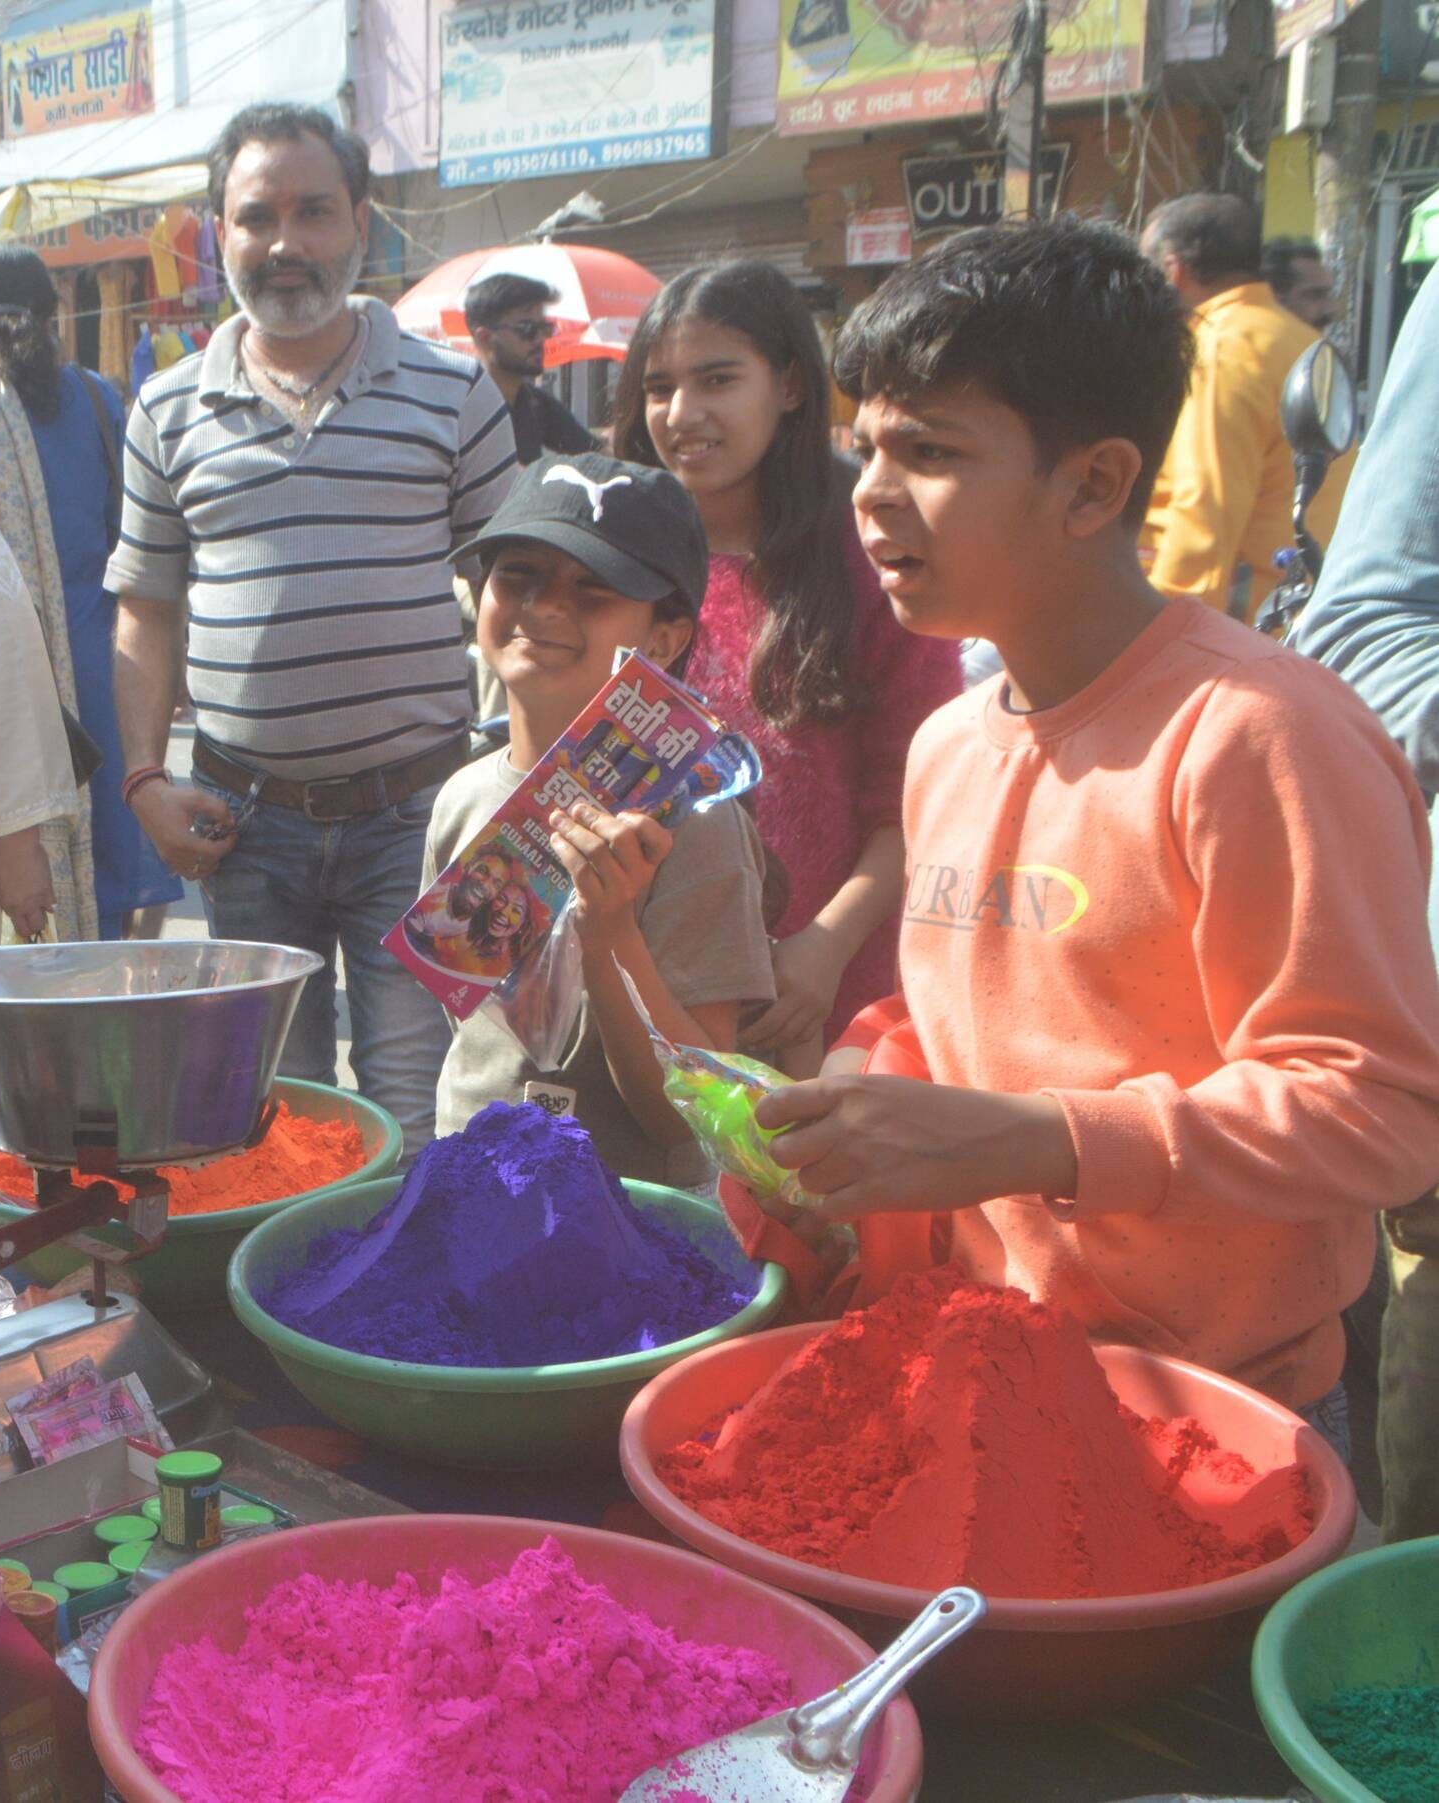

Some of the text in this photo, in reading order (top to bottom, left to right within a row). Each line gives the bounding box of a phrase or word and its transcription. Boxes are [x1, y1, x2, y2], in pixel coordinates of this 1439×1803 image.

[604, 678, 672, 742] होली
[655, 724, 701, 770] की
[498, 822, 570, 892] GULAAL FOG
[907, 863, 1053, 931] URBAN
